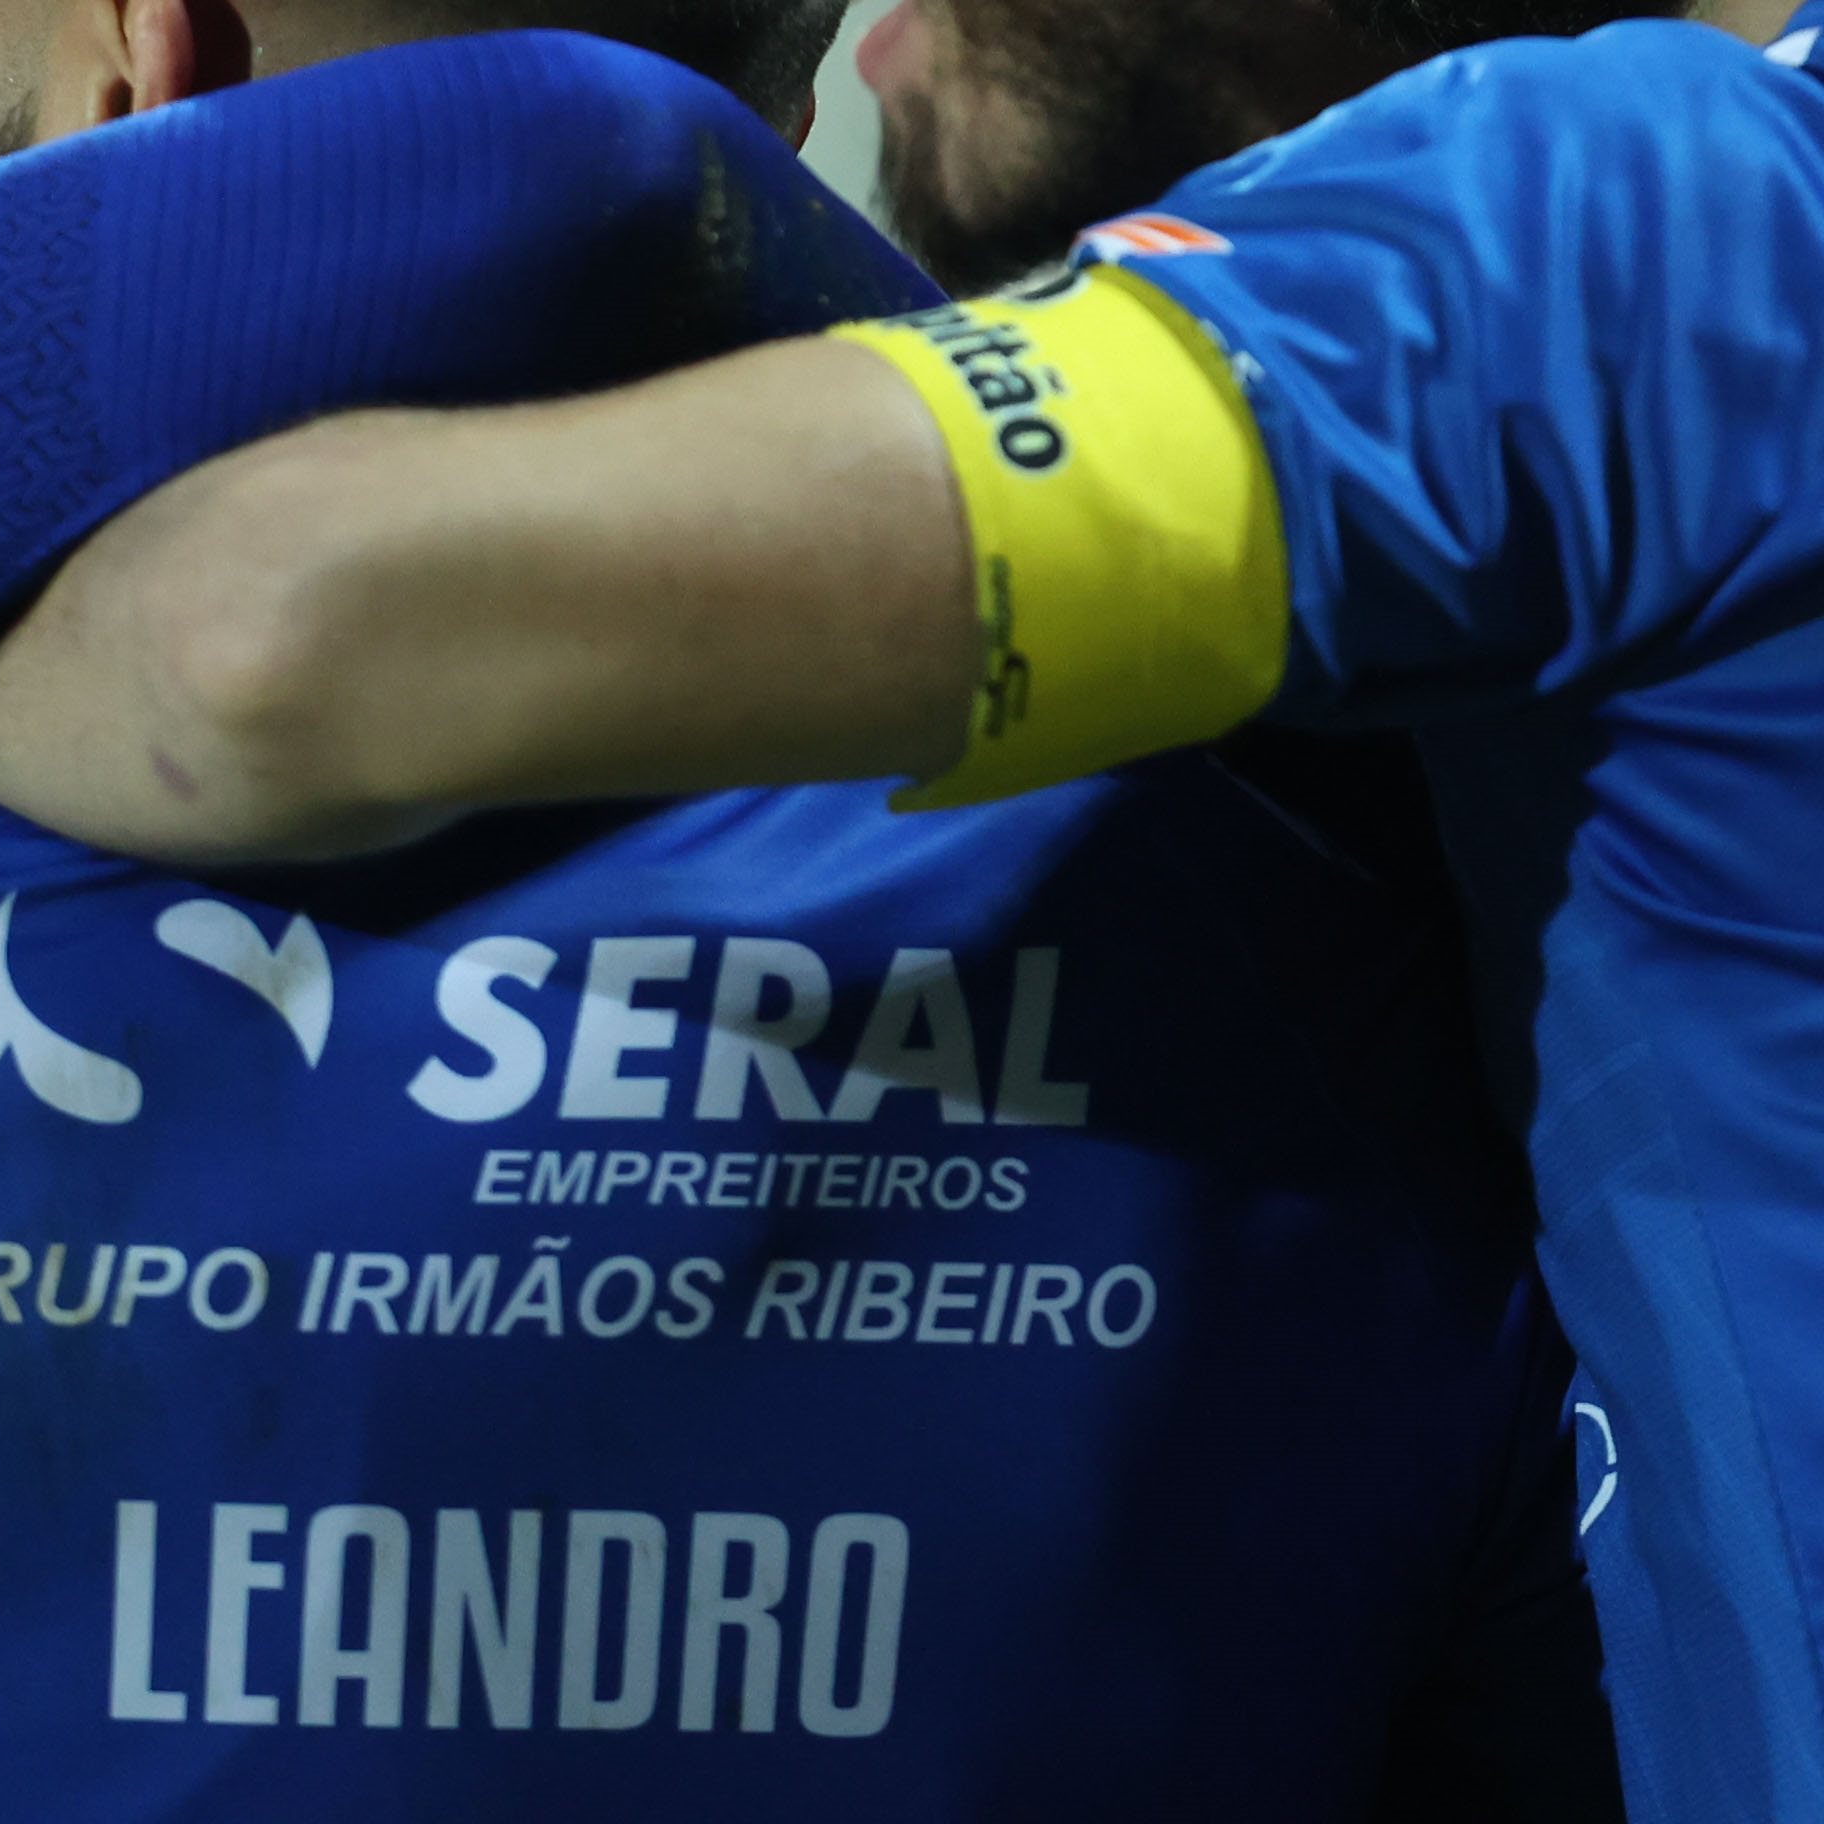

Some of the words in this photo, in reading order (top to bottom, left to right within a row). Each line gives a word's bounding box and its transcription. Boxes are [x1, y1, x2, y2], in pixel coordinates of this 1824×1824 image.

[405, 934, 1092, 1126] SERAL
[473, 1149, 1032, 1213] EMPREITEIROS
[298, 1234, 726, 1341] IRMÃOS
[743, 1260, 1159, 1351] RIBEIRO
[108, 1498, 912, 1740] LEANDRO
